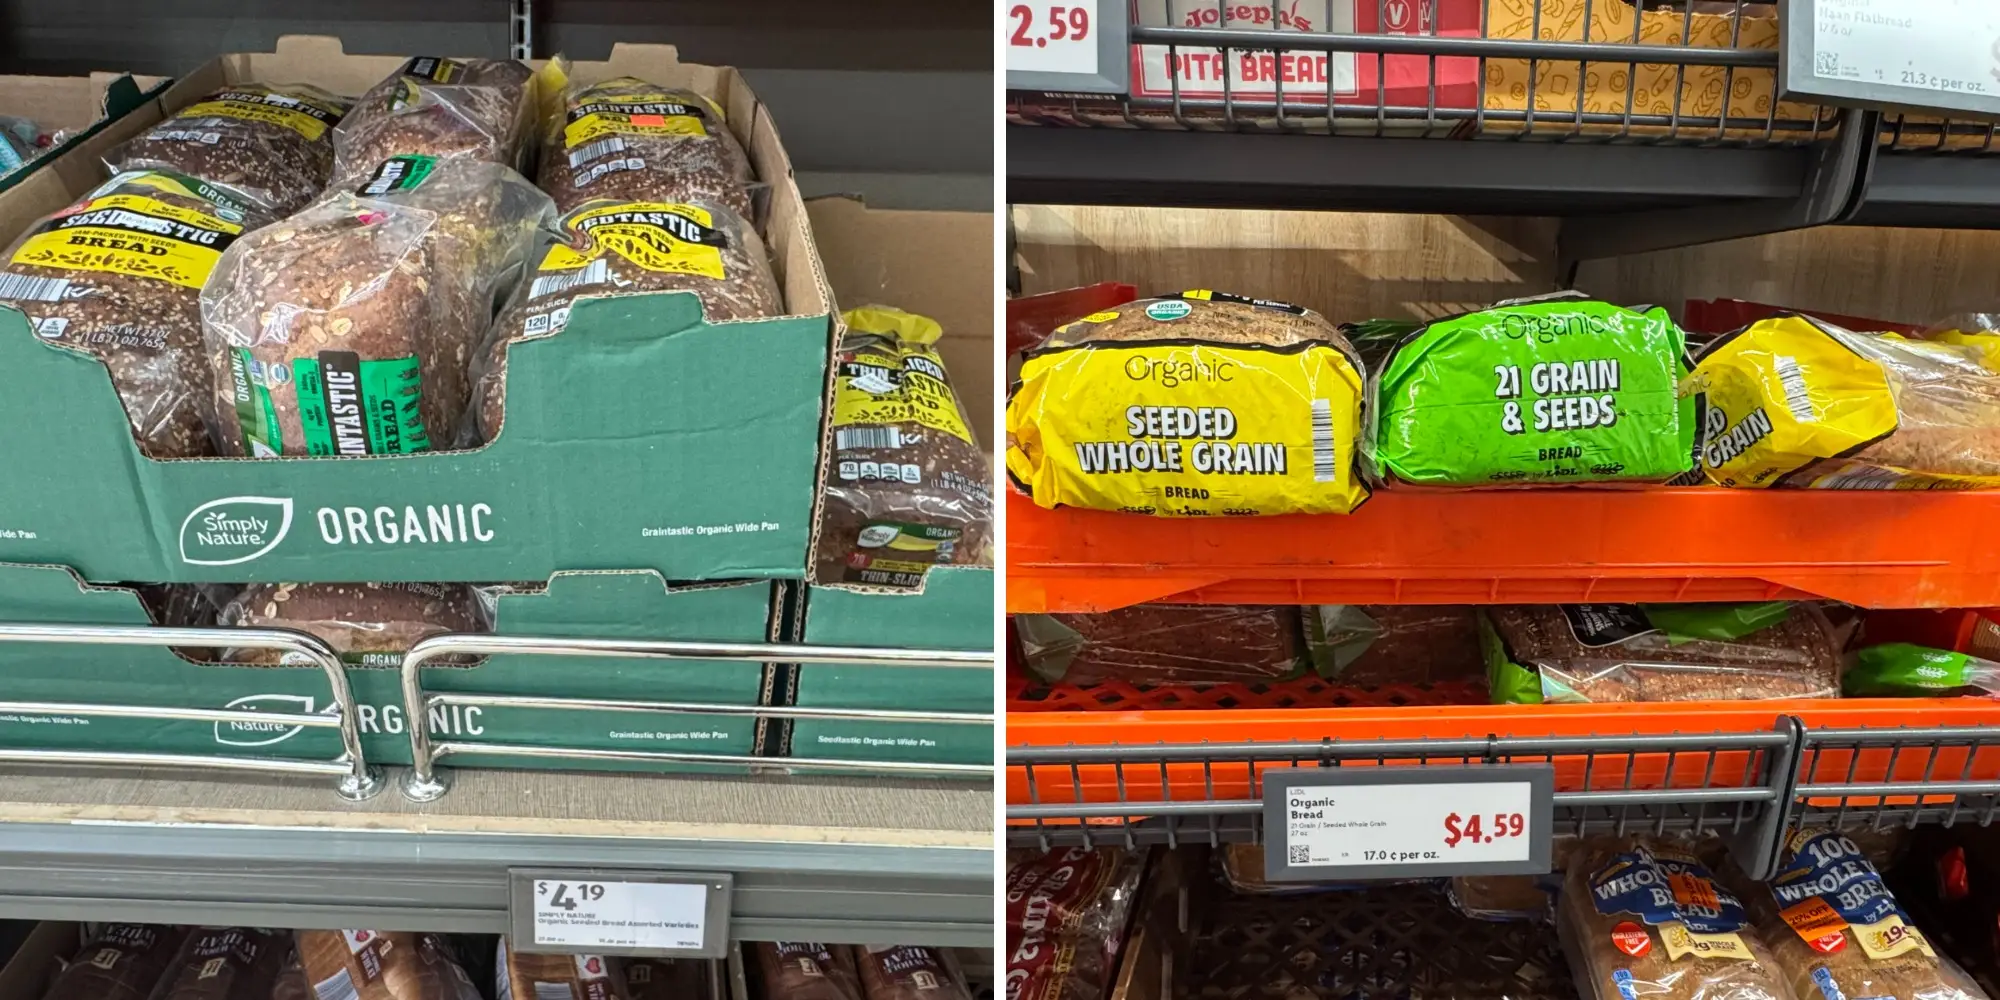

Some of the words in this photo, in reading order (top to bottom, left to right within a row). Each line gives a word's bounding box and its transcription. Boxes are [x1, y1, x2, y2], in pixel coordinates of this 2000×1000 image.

[1008, 4, 1089, 48] 2.59
[1901, 70, 1926, 84] 21.3
[1941, 77, 1963, 91] per
[575, 103, 686, 118] SEEDTASTIC
[67, 236, 168, 257] BREAD
[527, 316, 547, 328] 120
[1501, 312, 1604, 343] Organic
[231, 351, 250, 401] ORGANIC
[1125, 355, 1235, 387] Organic
[1493, 365, 1523, 398] 21
[1531, 359, 1621, 395] GRAIN
[1126, 405, 1238, 440] SEEDED
[1502, 401, 1526, 435] &
[1534, 395, 1618, 431] SEEDS
[1706, 407, 1774, 469] GRAIN
[1075, 442, 1184, 474] WHOLE
[1191, 442, 1288, 475] GRAIN
[1538, 447, 1583, 461] BREAD
[843, 463, 854, 471] 70
[1165, 486, 1210, 500] BREAD
[204, 513, 268, 534] Simply
[318, 504, 493, 544] ORGANIC
[642, 526, 694, 537] Graintastic
[696, 524, 734, 536] Organic
[735, 522, 759, 532] Wide
[761, 521, 780, 531] Pan
[926, 527, 961, 538] ORGANIC
[18, 530, 37, 539] Pan
[357, 704, 484, 736] RGNIC
[609, 731, 654, 739] Graintastic
[656, 731, 688, 740] Organic
[690, 731, 710, 739] Wide
[712, 731, 728, 739] Pan
[863, 737, 895, 746] Organic
[897, 738, 917, 746] Wide
[1290, 797, 1335, 809] Organic
[1291, 810, 1323, 819] Bread
[1444, 812, 1524, 848] $4.59
[1364, 851, 1387, 860] 17.0
[1390, 851, 1397, 860] ¢
[1400, 851, 1419, 864] per
[1423, 850, 1440, 860] oz.
[1775, 861, 1864, 901] WHOLE
[1810, 905, 1829, 918] OFF
[1864, 911, 1877, 922] by
